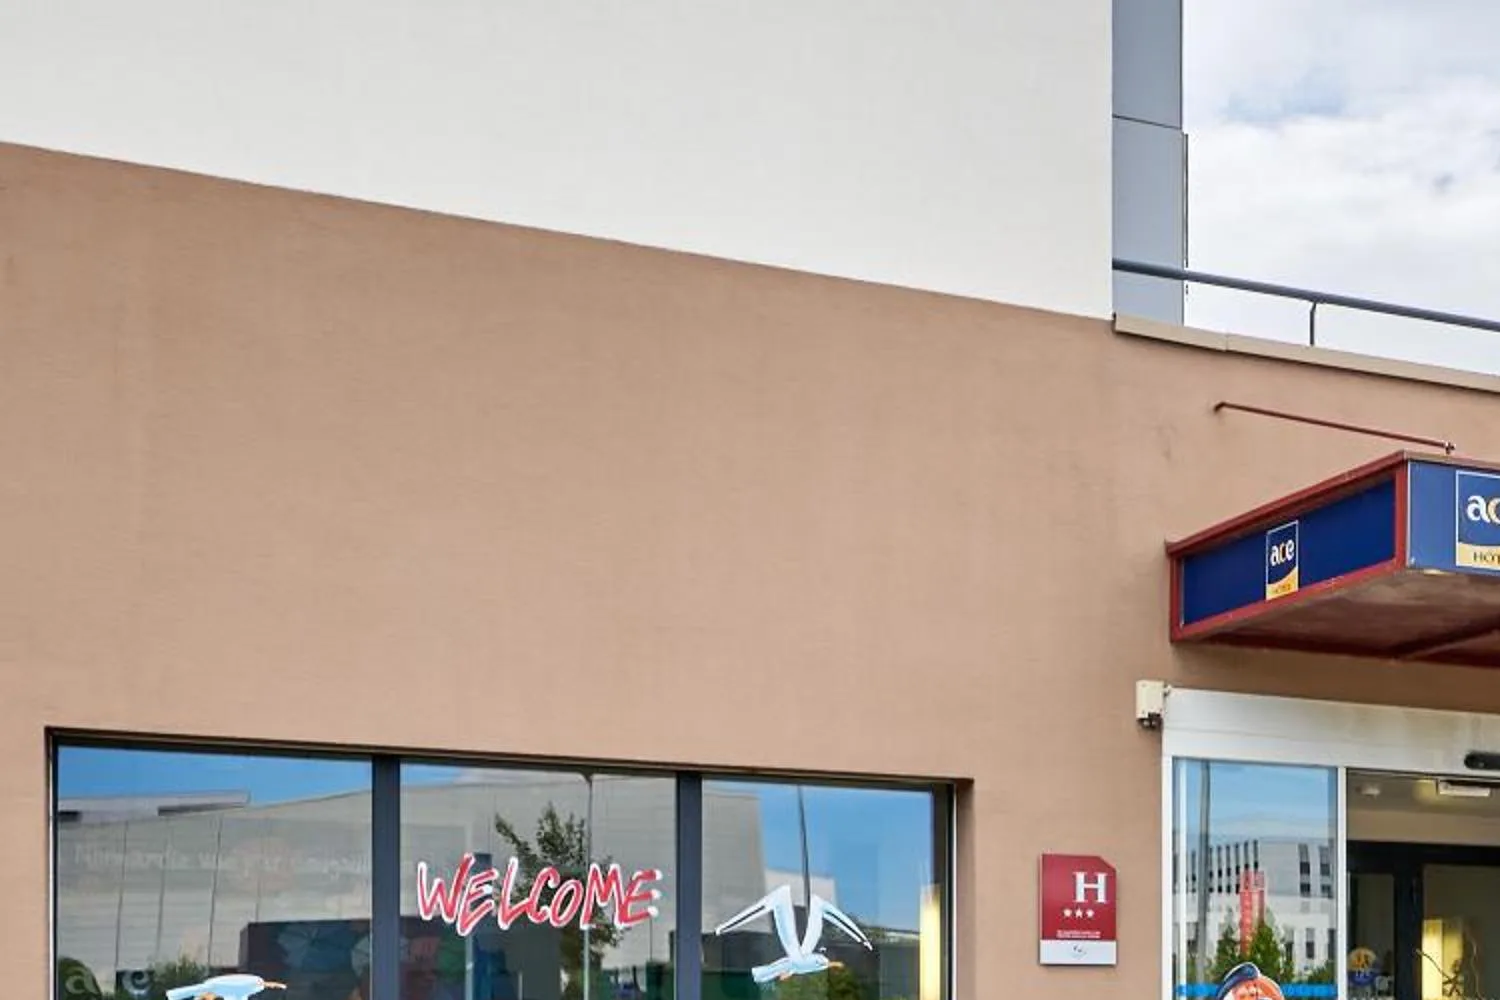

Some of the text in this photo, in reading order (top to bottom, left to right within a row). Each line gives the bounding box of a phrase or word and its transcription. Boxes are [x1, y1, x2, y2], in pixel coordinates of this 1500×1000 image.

[1270, 539, 1295, 567] ace
[417, 853, 662, 936] WELCOME
[1072, 871, 1108, 904] H
[65, 966, 152, 995] ae
